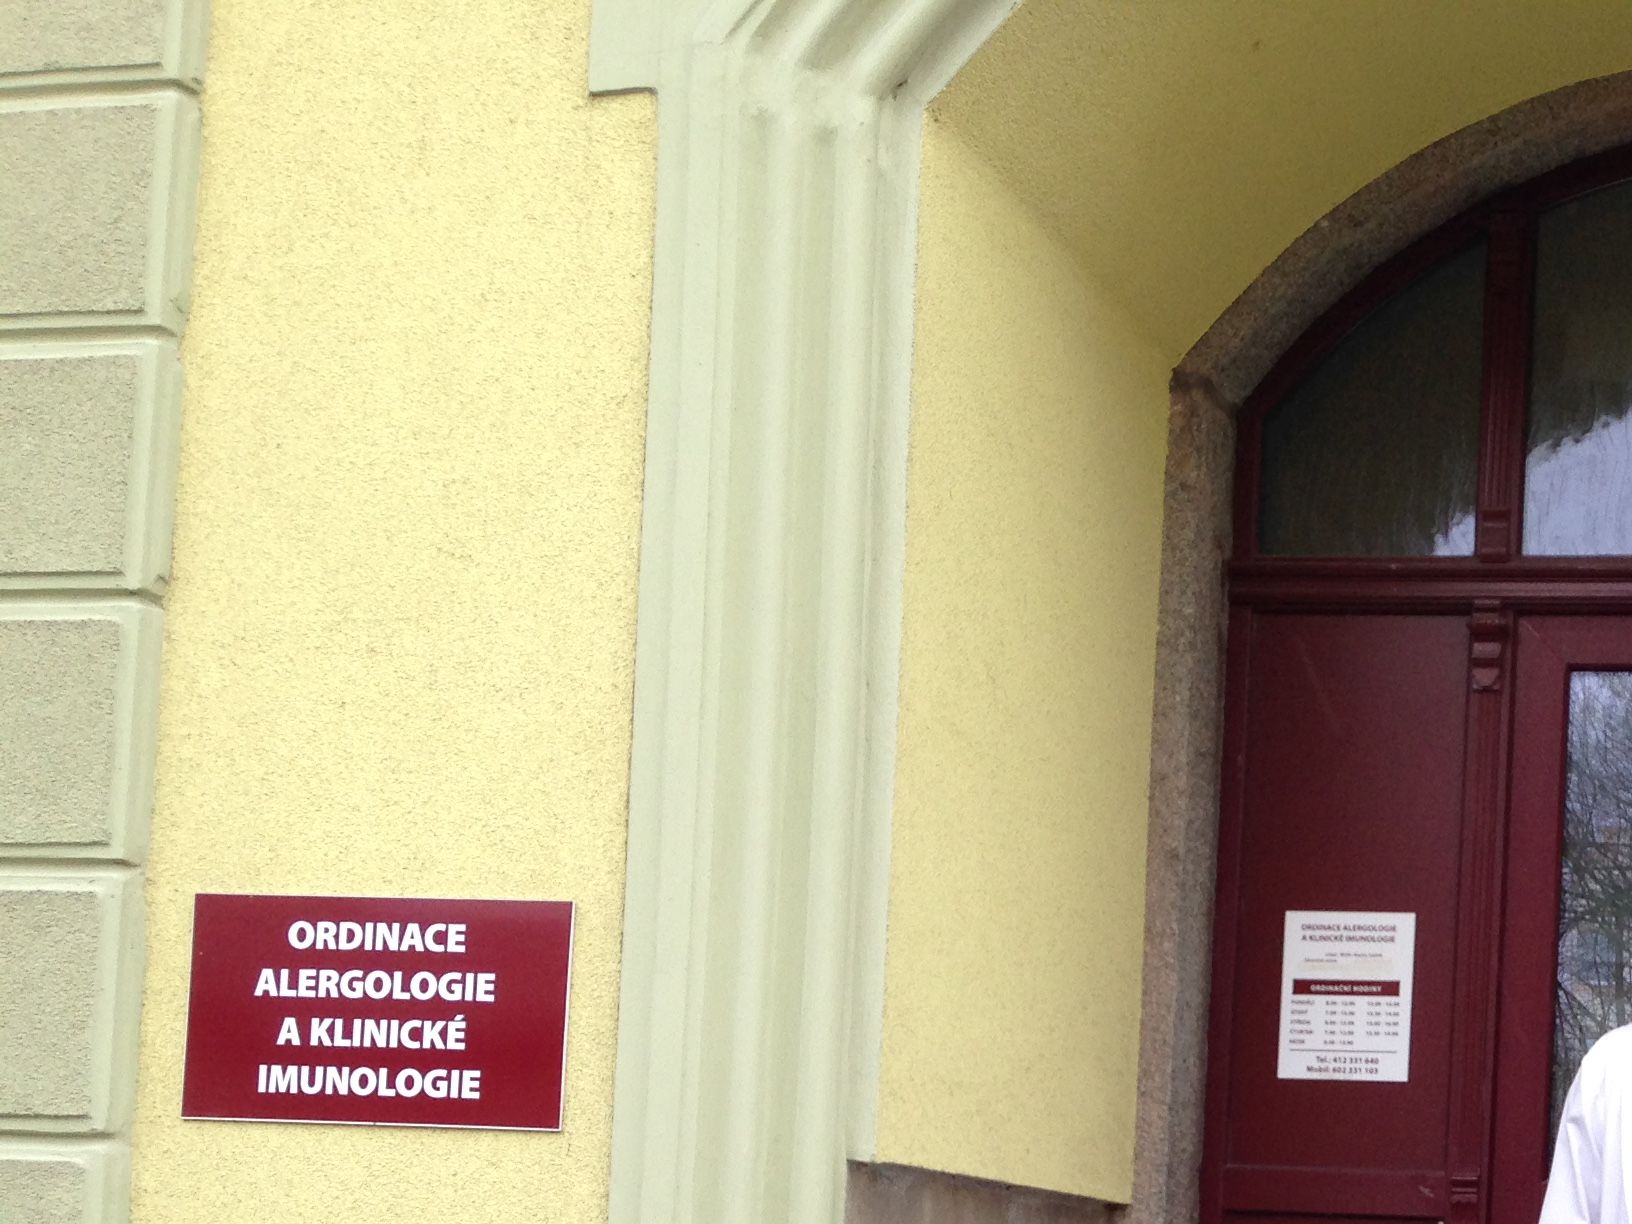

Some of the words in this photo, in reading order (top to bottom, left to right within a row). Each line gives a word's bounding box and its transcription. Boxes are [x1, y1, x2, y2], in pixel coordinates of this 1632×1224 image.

[288, 920, 467, 953] ORDINACE
[1301, 923, 1341, 932] ORDINACE
[1343, 924, 1397, 933] ALERGOLOGIE
[1301, 934, 1308, 942] A
[1345, 935, 1396, 944] IMUNOLOGIE
[253, 967, 497, 1003] ALERGOLOGIE
[275, 1016, 301, 1046] A
[309, 1014, 466, 1051] KLINICKÉ
[257, 1063, 482, 1100] IMUNOLOGIE
